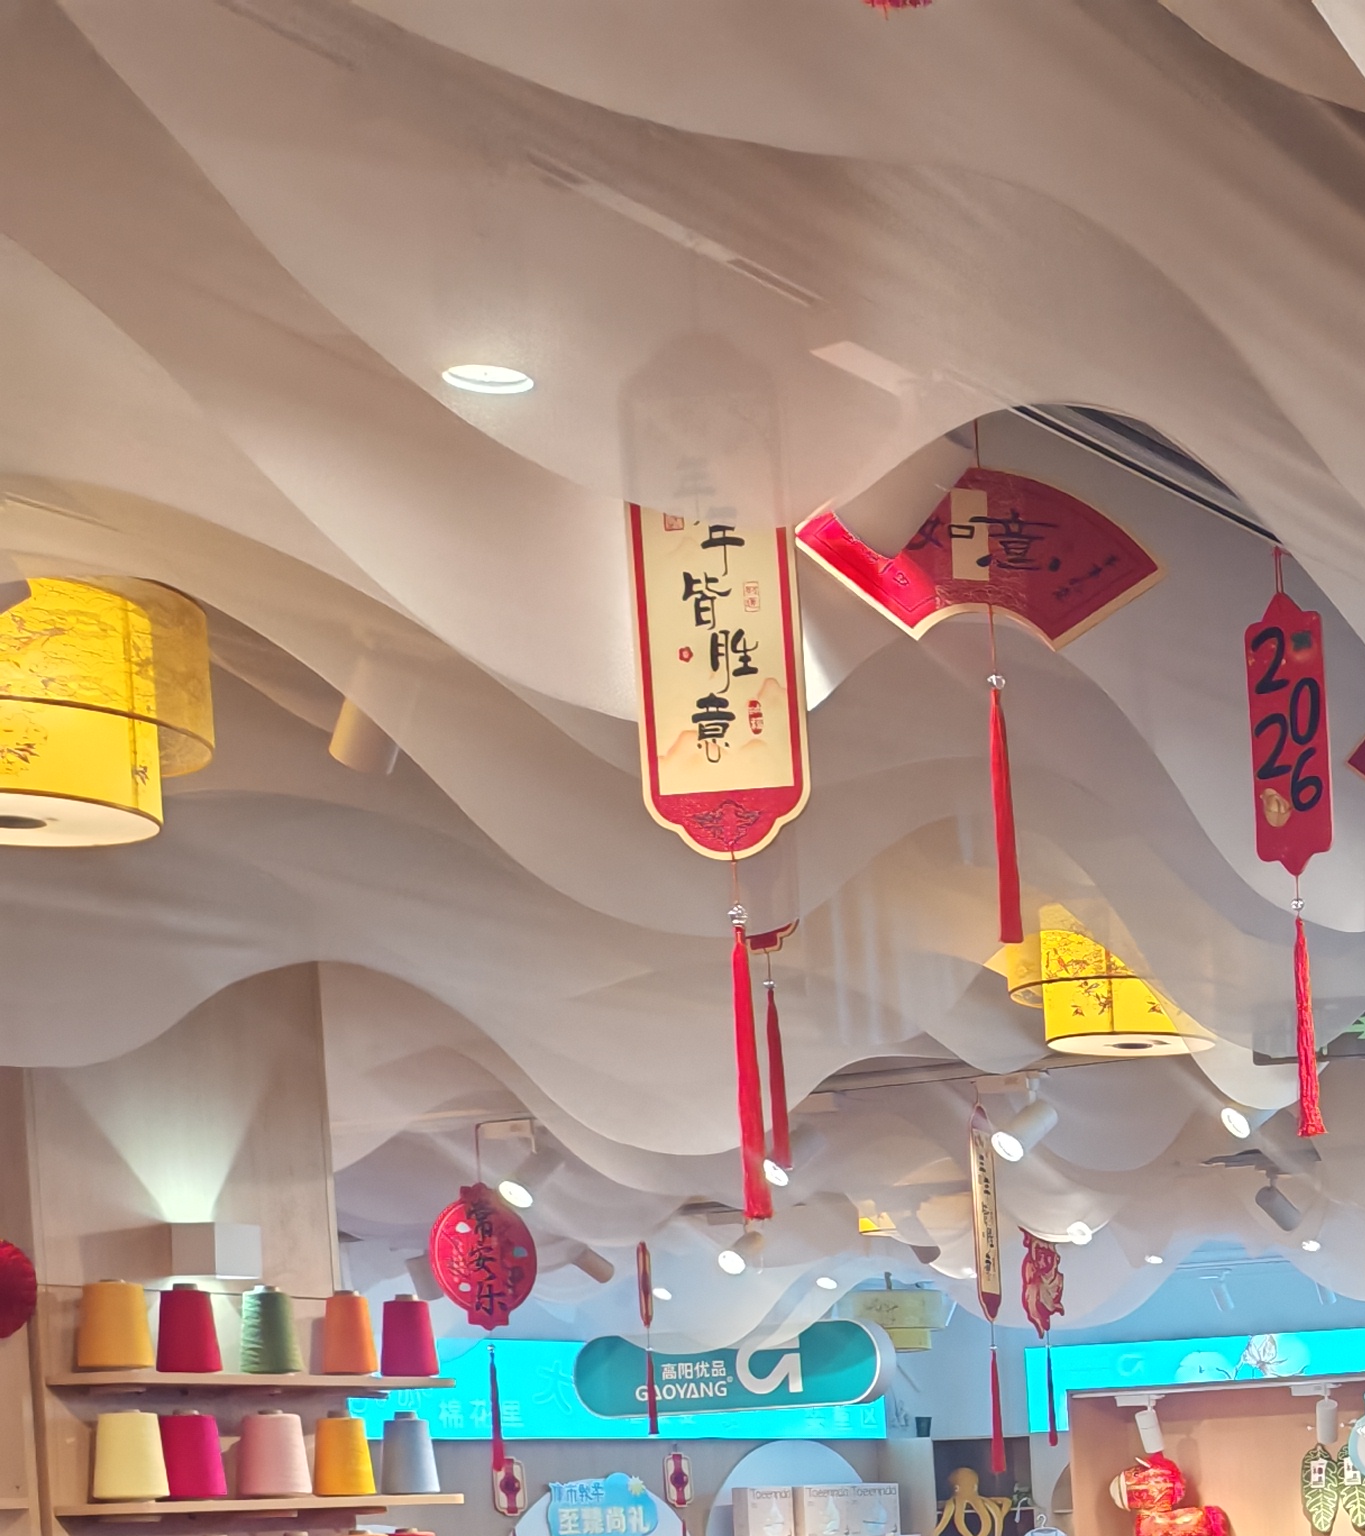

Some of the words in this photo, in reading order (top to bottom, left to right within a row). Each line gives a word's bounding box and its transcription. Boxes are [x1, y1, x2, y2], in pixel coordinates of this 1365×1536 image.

[1251, 627, 1322, 812] 2026
[661, 1360, 726, 1380] 高阳优品
[635, 1381, 728, 1402] GAOYANG
